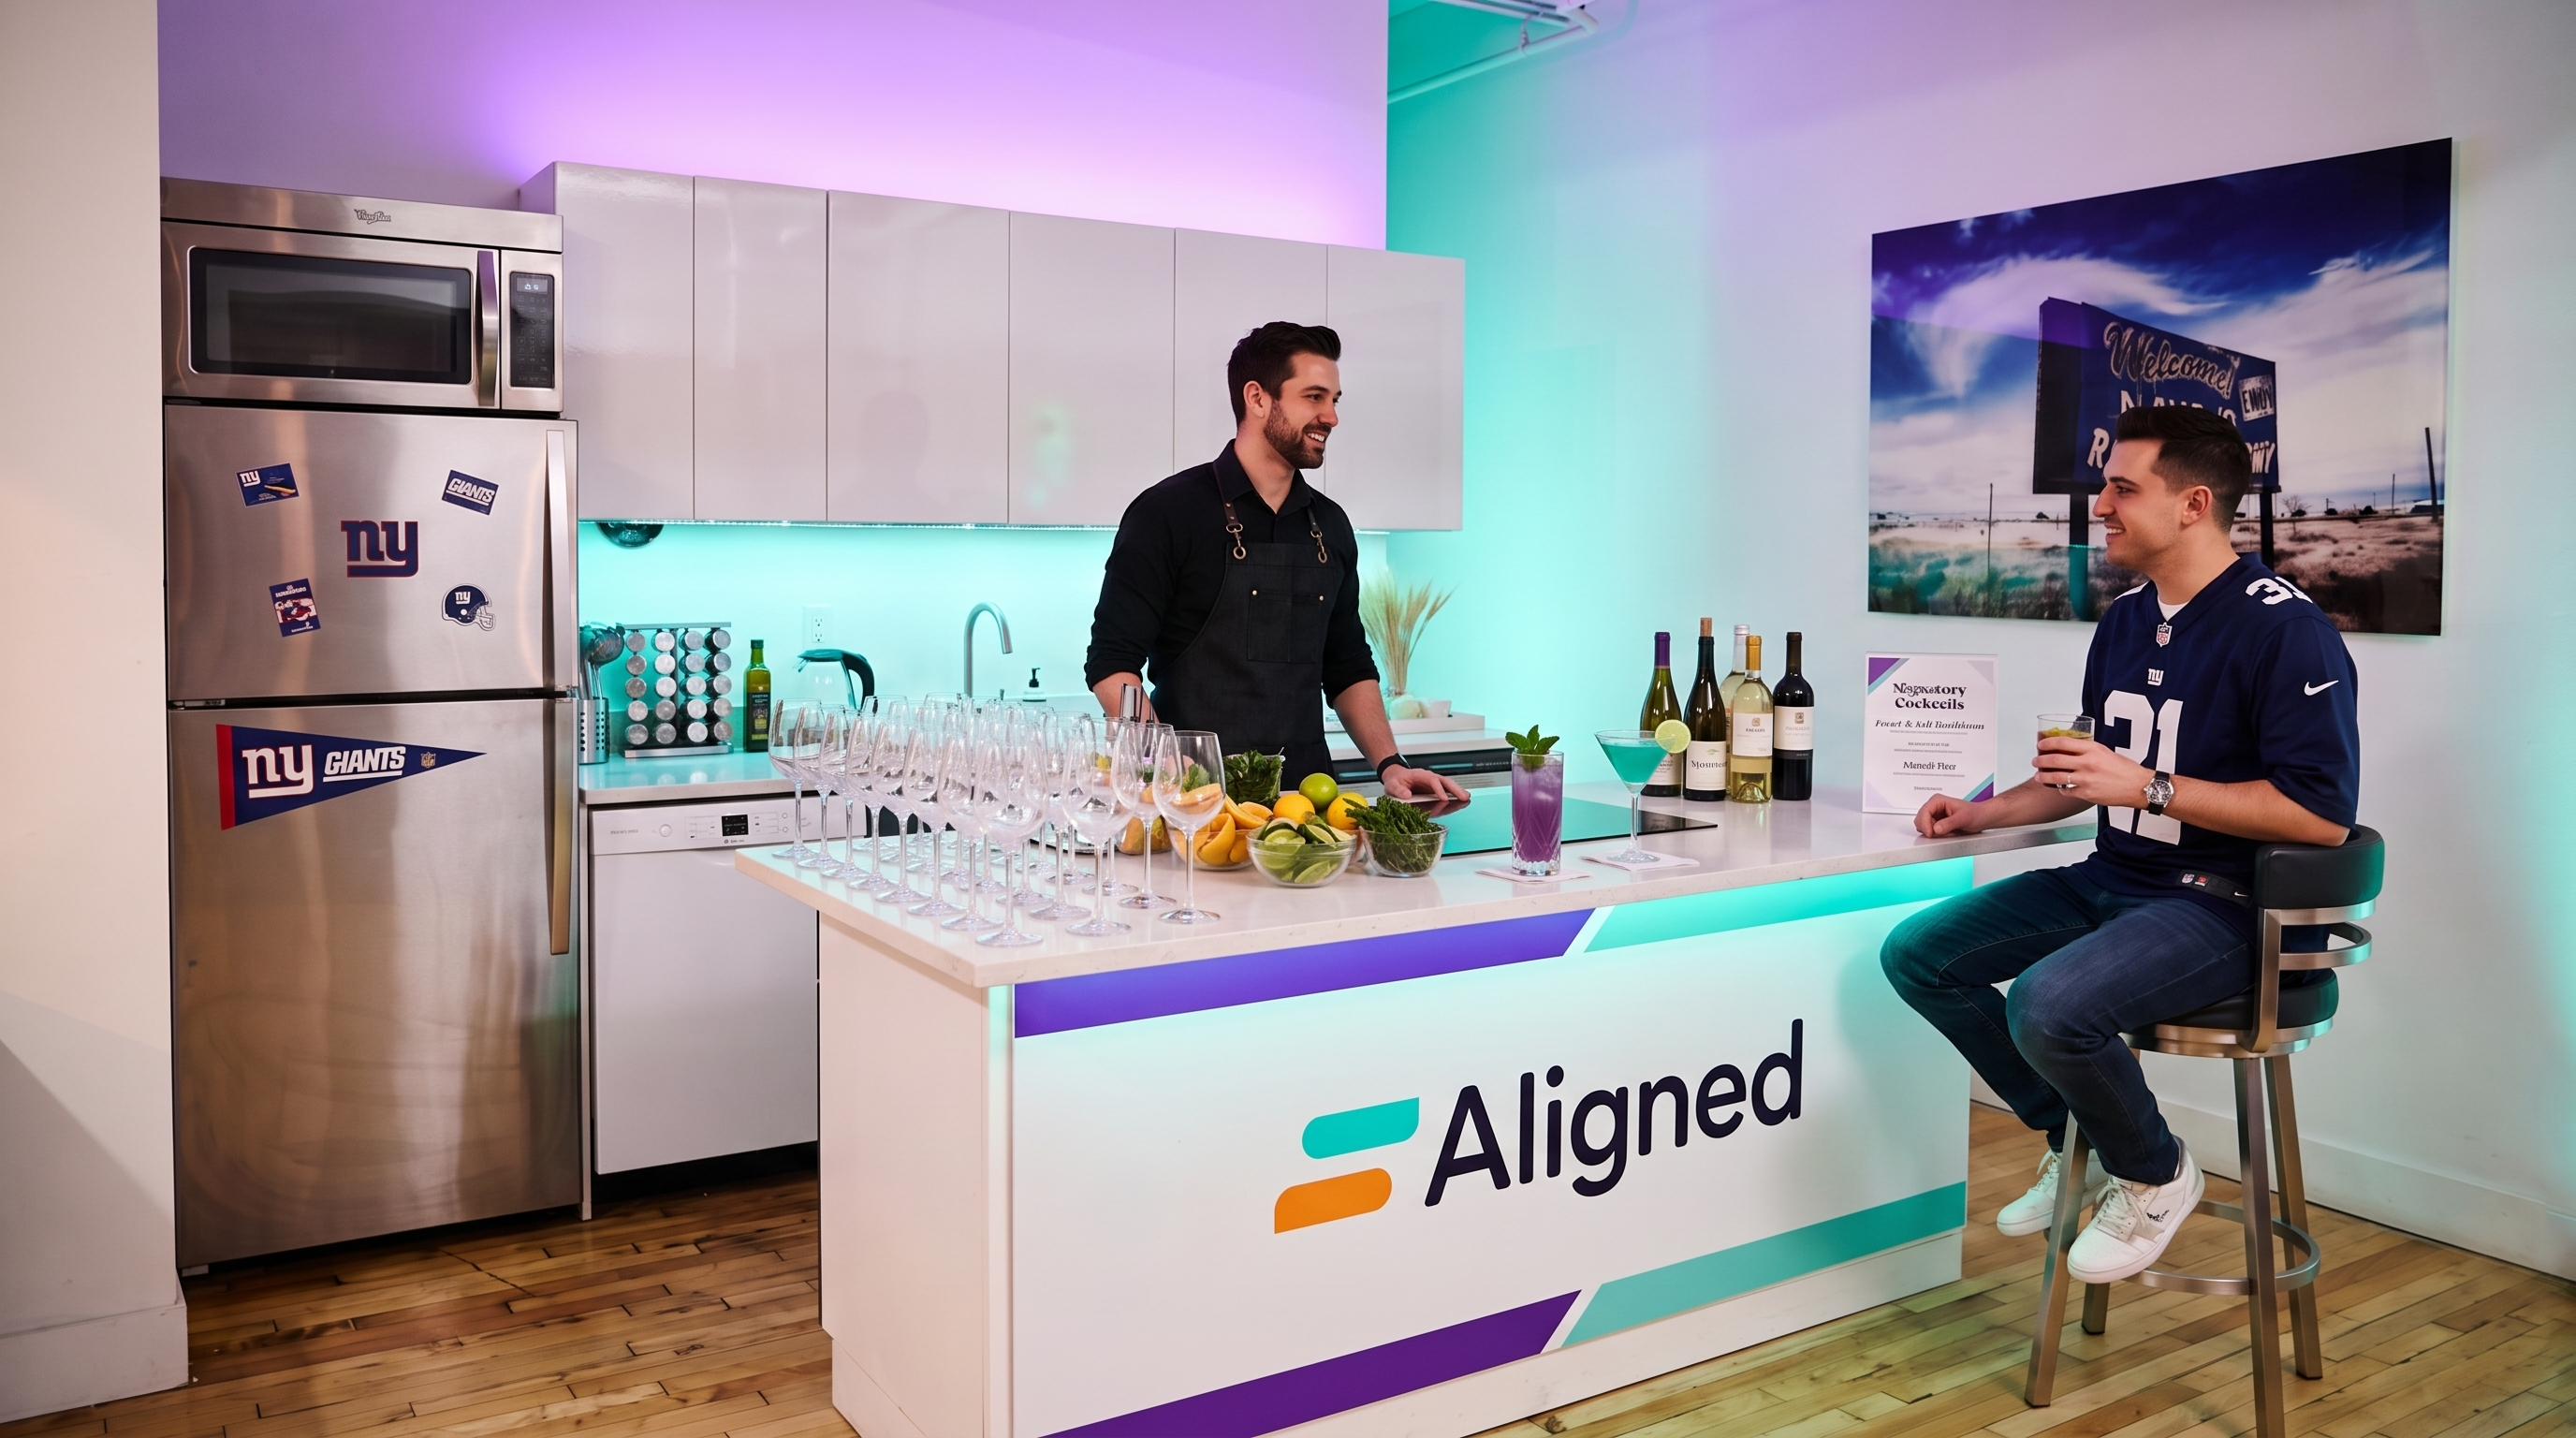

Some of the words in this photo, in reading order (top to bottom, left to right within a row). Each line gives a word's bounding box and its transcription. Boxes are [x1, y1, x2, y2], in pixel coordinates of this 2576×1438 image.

[447, 477, 496, 503] GIANTS
[2245, 576, 2314, 605] 31
[1905, 720, 1913, 728] &
[324, 746, 406, 776] GIANTS
[2103, 689, 2184, 845] 31
[1424, 1018, 1805, 1208] Aligned
